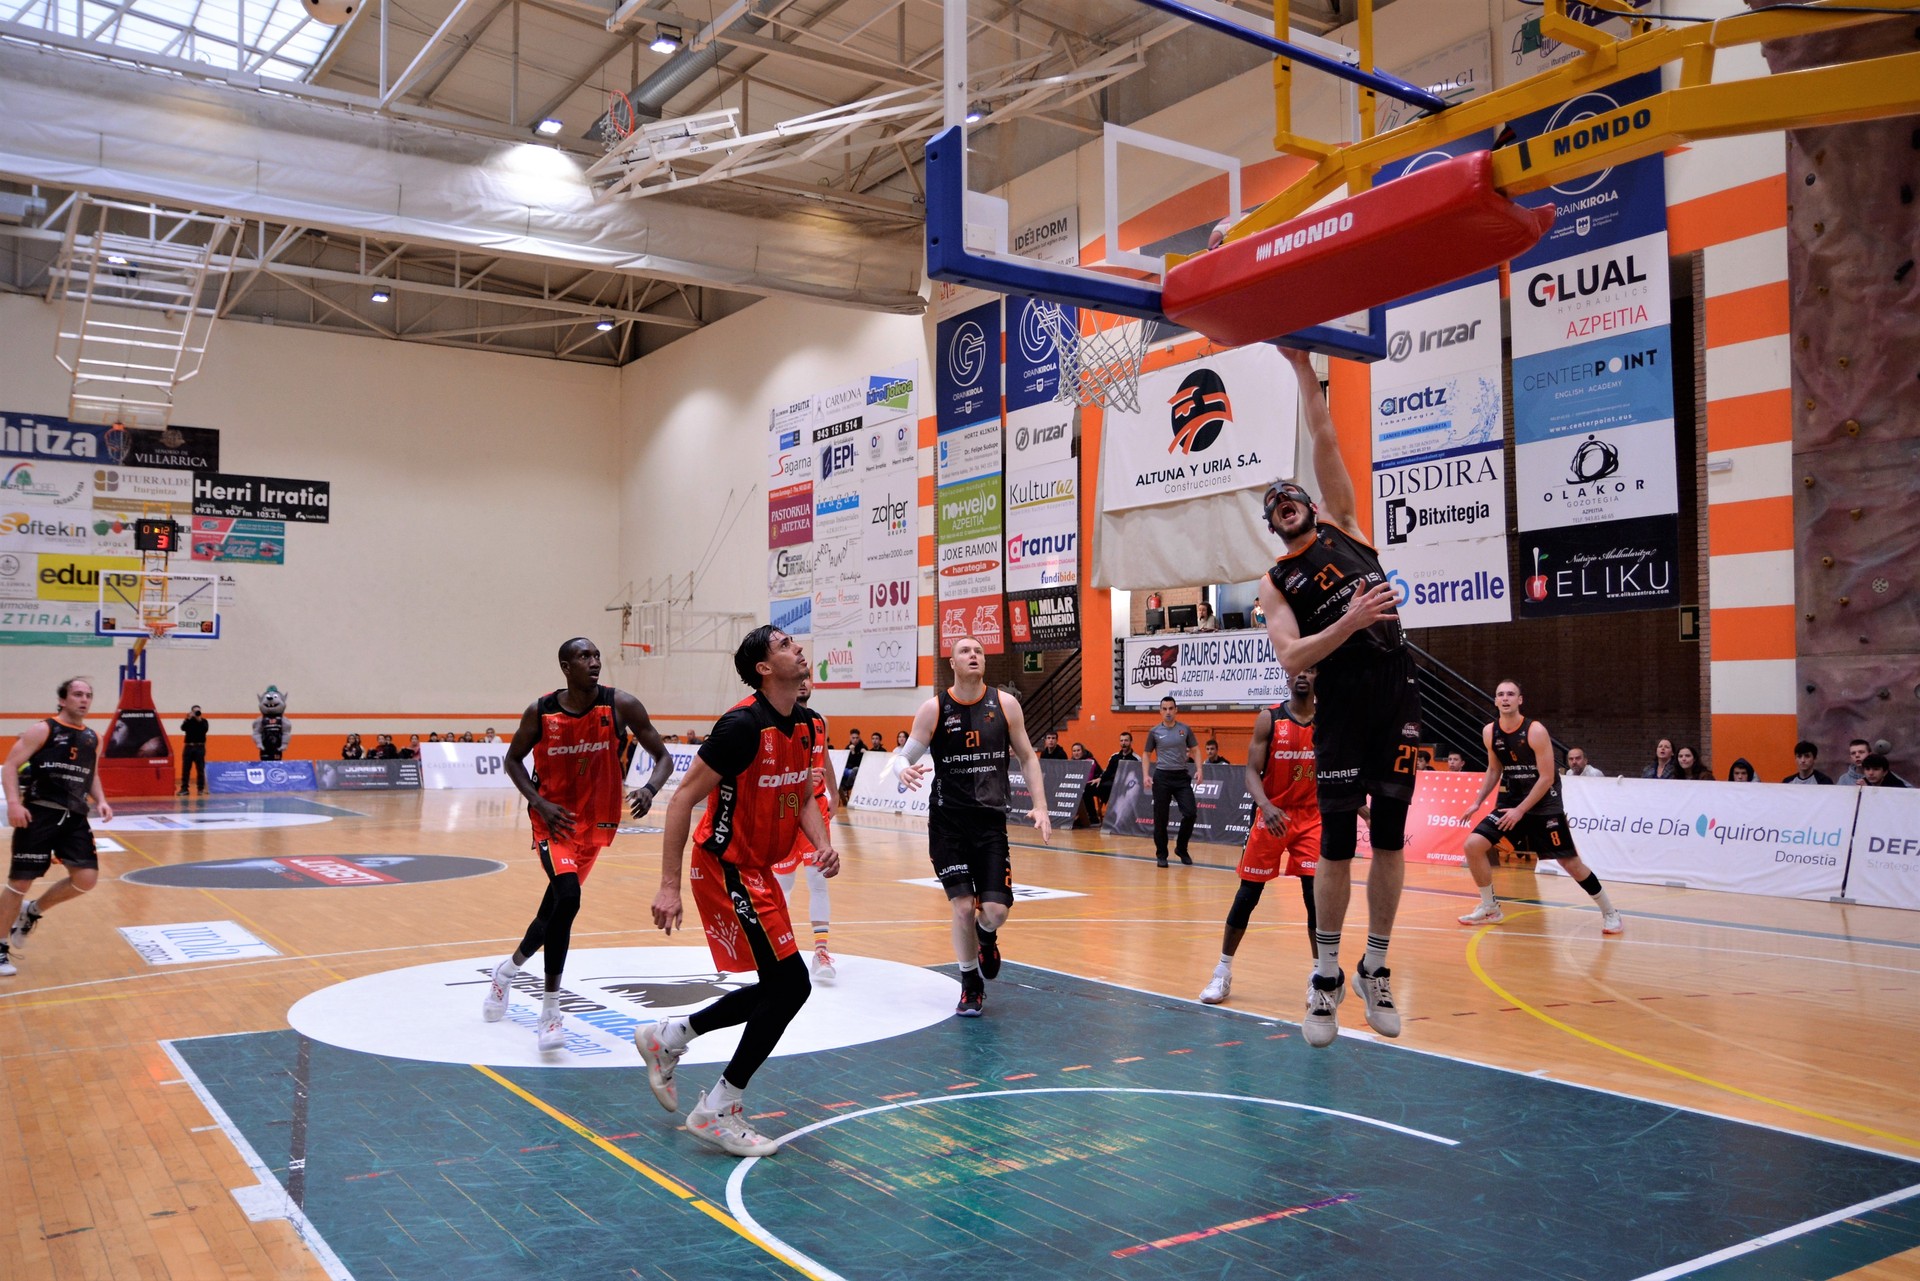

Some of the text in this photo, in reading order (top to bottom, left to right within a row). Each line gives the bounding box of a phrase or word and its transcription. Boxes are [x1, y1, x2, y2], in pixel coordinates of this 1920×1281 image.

[1554, 108, 1651, 157] MONDO
[1274, 212, 1354, 257] MONDO
[1528, 255, 1647, 308] GLUAL
[1558, 286, 1648, 314] HYDRAULICS
[1566, 304, 1648, 339] AZPEITIA
[1419, 320, 1481, 353] Irizar
[825, 387, 862, 408] CARMONA
[866, 379, 913, 406] kiroljokoa
[1555, 380, 1622, 400] ENGLISH ACADEMY
[1379, 386, 1446, 416] aratz
[817, 419, 857, 440] 943 151 514
[980, 426, 998, 435] KLINIKA
[1549, 412, 1632, 434] www.centerpoint.eus
[1033, 423, 1068, 445] Irizar
[135, 453, 208, 467] VILLARRICA
[771, 454, 812, 477] Sagarna
[834, 443, 854, 470] EPI
[1136, 452, 1262, 487] ALTUNA Y URIA S.A.
[1378, 456, 1498, 499] DISDIRA
[122, 474, 191, 487] ITURRALDE
[133, 486, 176, 495] Iturgintza
[1165, 474, 1231, 494] Construcciones
[1544, 479, 1644, 502] OLAKOR
[195, 479, 328, 506] Herri Irratia
[818, 491, 857, 509] iragaz
[1010, 479, 1074, 505] Kulturaz
[1567, 496, 1619, 508] GOZOTEGIA
[771, 504, 811, 522] PASTORKUA
[952, 515, 984, 530] AZPEITIA
[1419, 501, 1489, 527] Bitxitegia
[780, 518, 811, 533] JATETXEA
[157, 535, 169, 548] 3
[942, 541, 997, 561] JOXE RAMON
[1009, 532, 1076, 559] aranur
[952, 562, 987, 574] harategia
[1041, 570, 1075, 584] fundibide
[1314, 563, 1345, 591] 27
[1414, 569, 1445, 579] GRUPO
[1414, 571, 1504, 605] sarralle
[1557, 561, 1669, 597] ELIKU
[870, 581, 910, 608] IOSU
[1038, 597, 1074, 615] MILAR
[869, 610, 910, 624] OPTIKA
[1031, 613, 1074, 627] LARRAMENDI
[828, 648, 853, 665] AÑOTA
[1145, 655, 1161, 666] ISB
[1181, 641, 1220, 666] IRAURGI
[1223, 639, 1253, 664] SASKI
[884, 662, 910, 673] OPTIKA
[1132, 666, 1178, 684] IRAURGI
[1181, 670, 1214, 682] AZPEITIA
[1220, 669, 1258, 681] AZKOITIA
[1168, 688, 1204, 697] www.isb.eus
[1248, 687, 1272, 696] e-maila:
[965, 730, 980, 748] 21
[70, 747, 78, 760] 5
[1274, 747, 1315, 760] COVIR
[577, 758, 588, 776] 7
[1293, 764, 1314, 781] 34
[1317, 768, 1360, 779] JUARIS
[779, 792, 798, 818] 19
[853, 795, 906, 808] AZKOITIKO
[1550, 831, 1560, 846] 8
[1565, 813, 1842, 847] ospital de Día quirónsalud
[1868, 836, 1920, 856] DEF
[1775, 850, 1836, 866] Donostia
